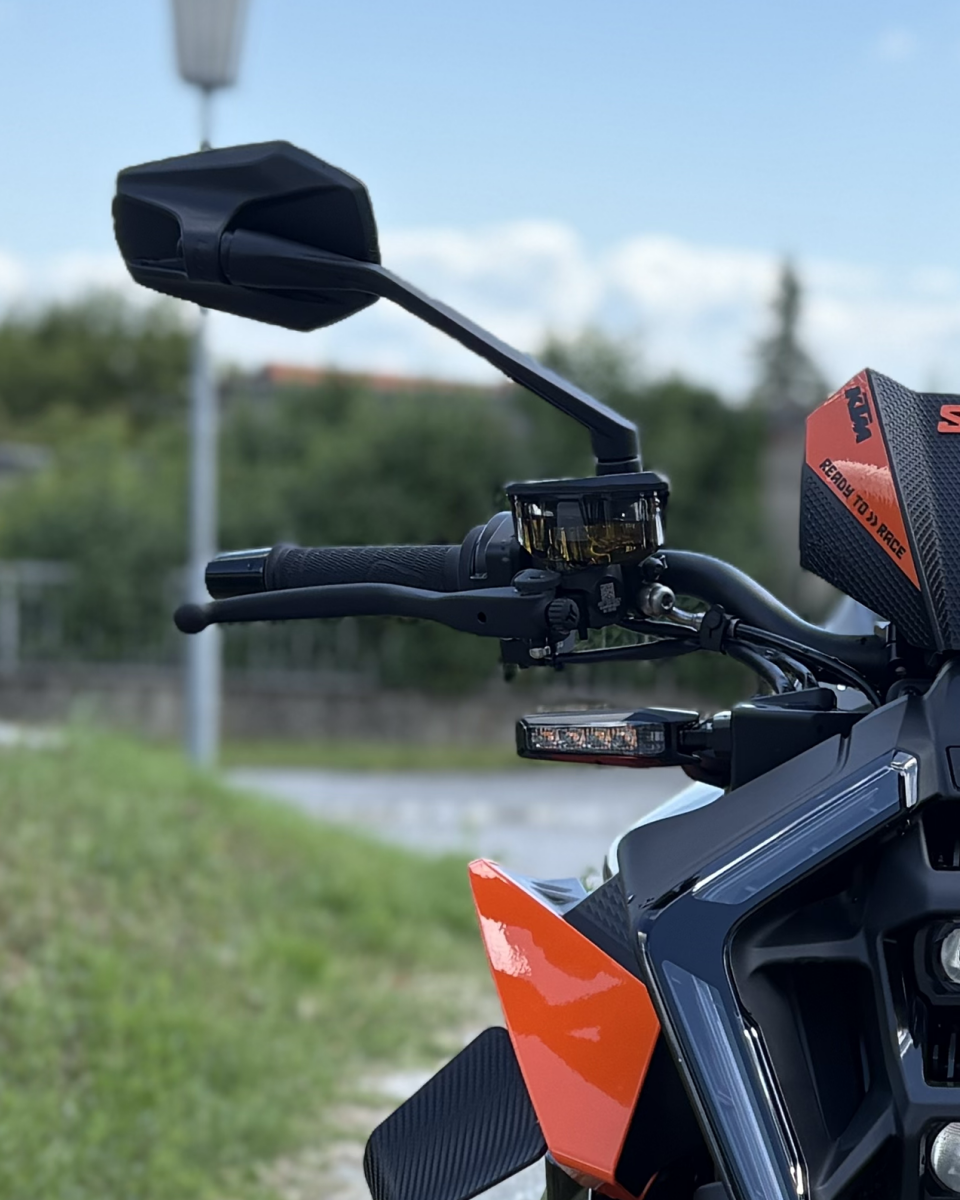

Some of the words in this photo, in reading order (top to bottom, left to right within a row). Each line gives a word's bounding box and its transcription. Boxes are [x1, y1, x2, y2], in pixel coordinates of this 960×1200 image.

[845, 386, 873, 444] KTM
[819, 458, 855, 498] READY
[852, 494, 869, 516] TO
[876, 523, 907, 560] RACE
